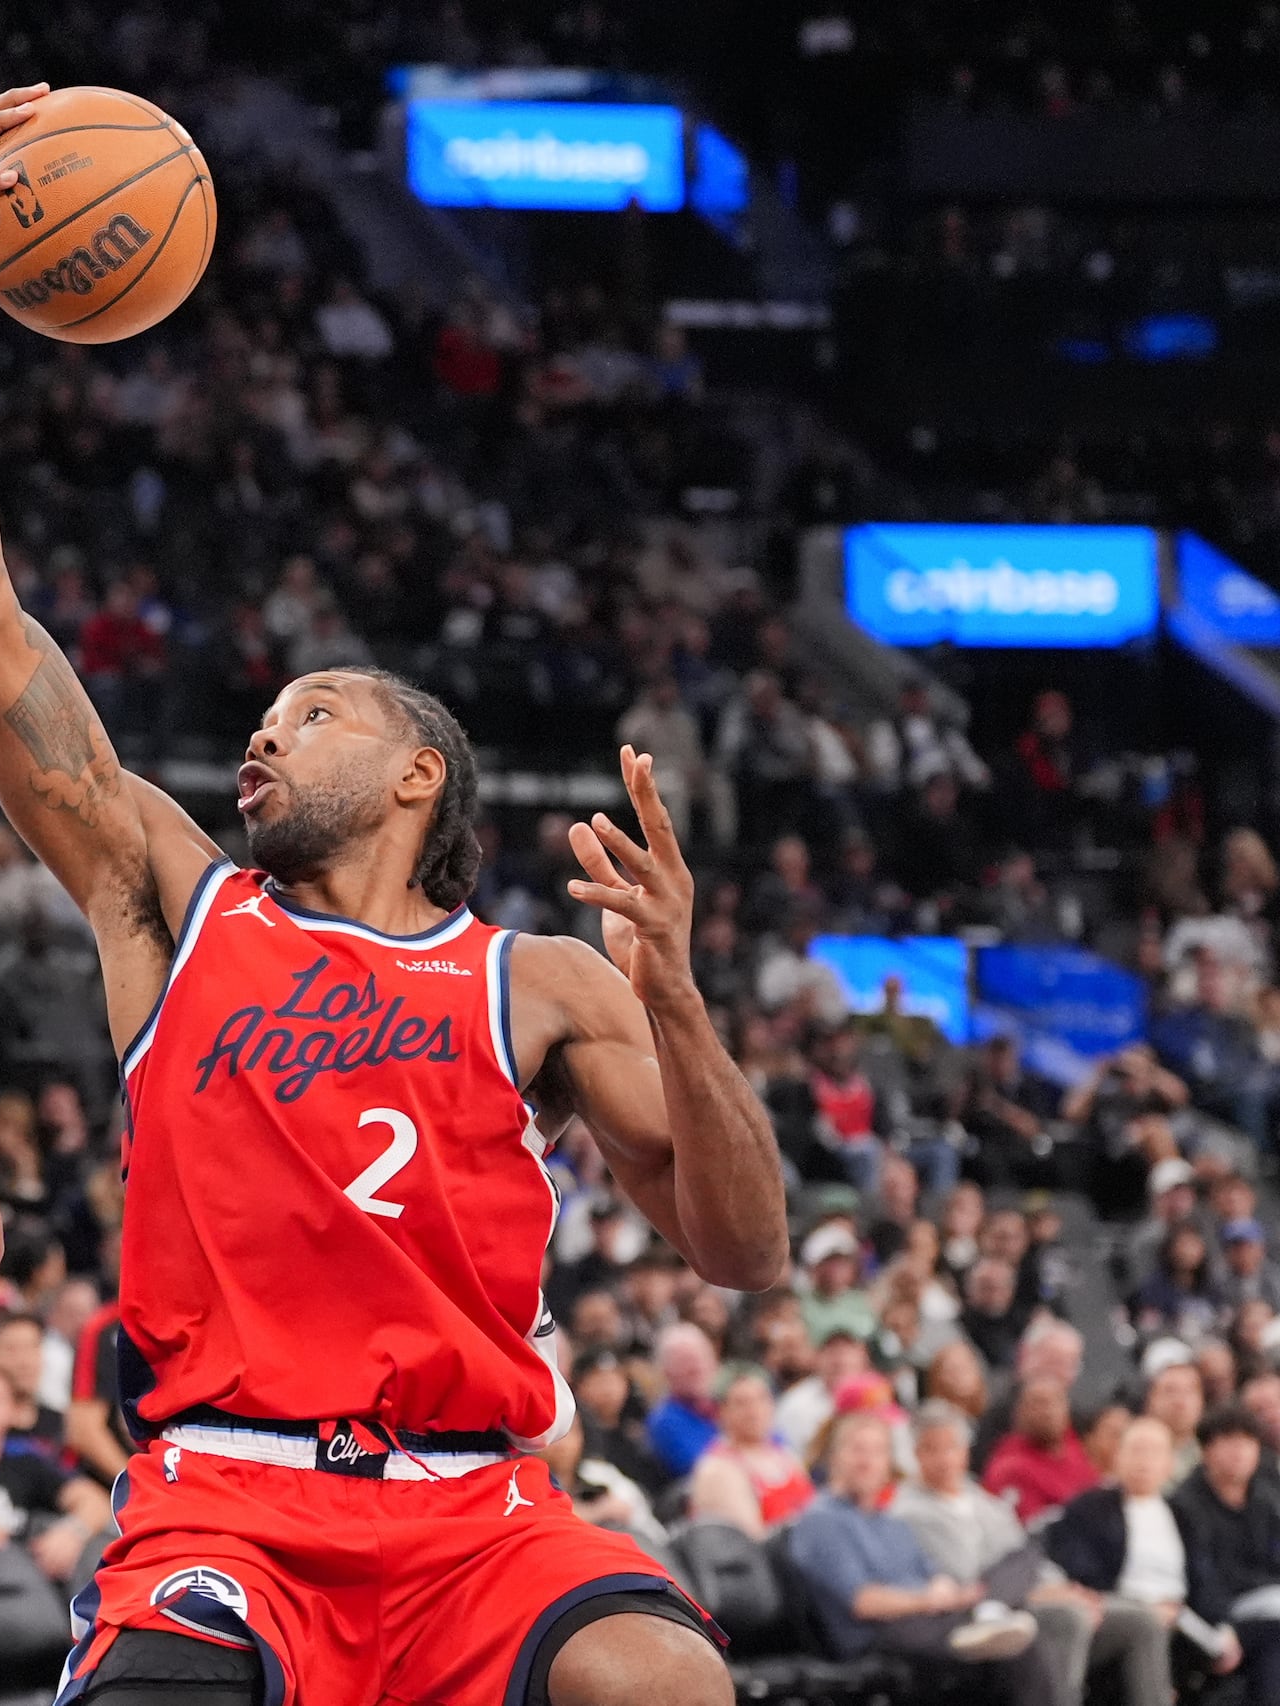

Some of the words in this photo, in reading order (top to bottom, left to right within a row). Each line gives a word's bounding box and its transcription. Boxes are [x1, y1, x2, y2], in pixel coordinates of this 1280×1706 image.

[1, 213, 154, 310] Wilson
[272, 955, 384, 1023] Los
[412, 960, 457, 968] VISIT
[194, 996, 460, 1104] Angeles
[342, 1107, 418, 1219] 2
[327, 1433, 374, 1465] Clip
